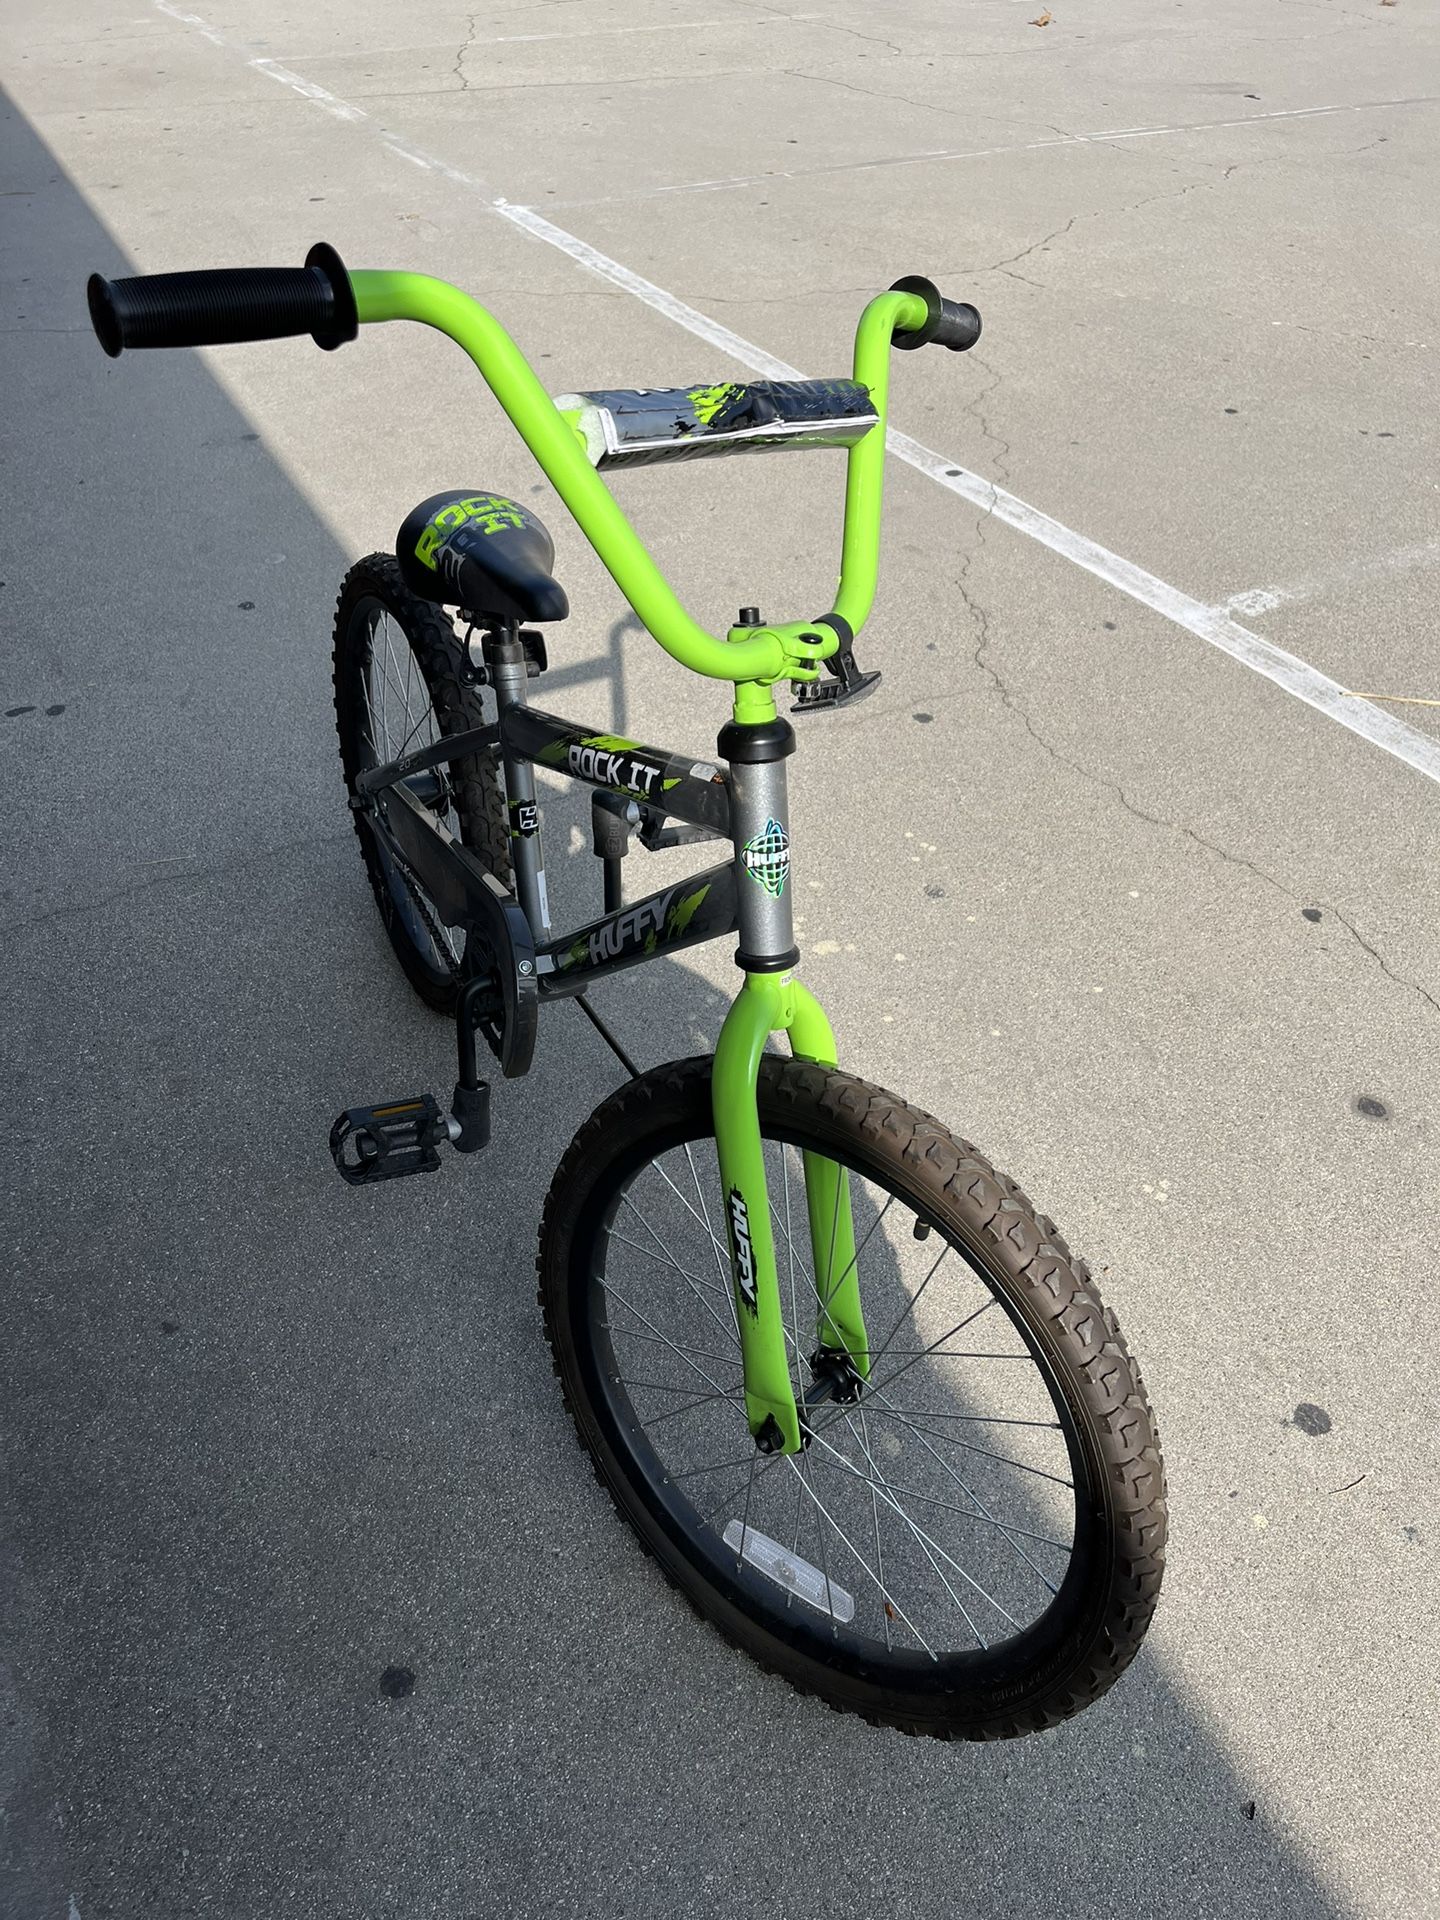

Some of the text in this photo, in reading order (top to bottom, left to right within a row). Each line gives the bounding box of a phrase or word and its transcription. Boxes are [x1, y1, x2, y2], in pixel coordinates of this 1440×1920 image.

[414, 496, 519, 571] ROCK
[475, 511, 526, 535] IT
[568, 744, 660, 794] ROCK IT
[588, 890, 675, 966] HUFFY
[730, 1194, 756, 1302] HUFFY
